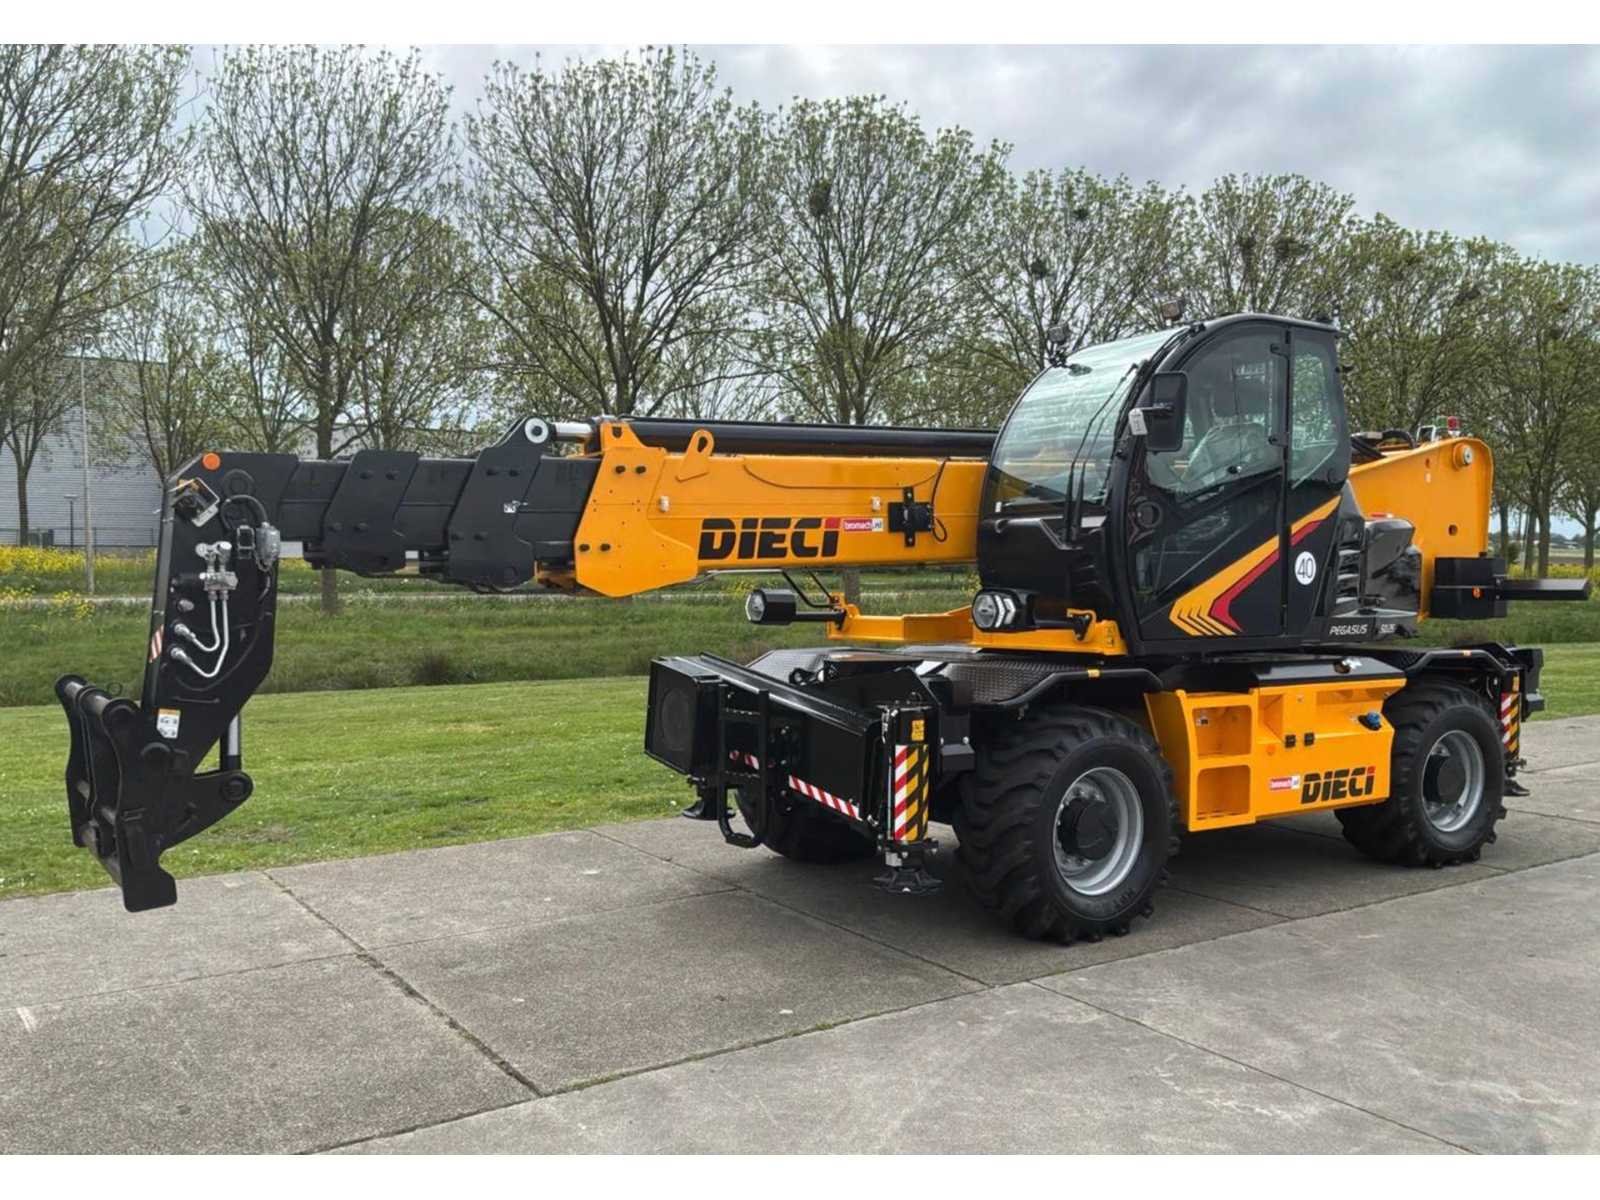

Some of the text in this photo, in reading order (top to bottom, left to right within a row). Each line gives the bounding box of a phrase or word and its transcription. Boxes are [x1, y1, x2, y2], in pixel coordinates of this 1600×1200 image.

[698, 517, 841, 560] DIECI
[1297, 557, 1314, 579] 40
[1329, 623, 1369, 636] PEGASUS
[1301, 766, 1376, 804] DIECI
